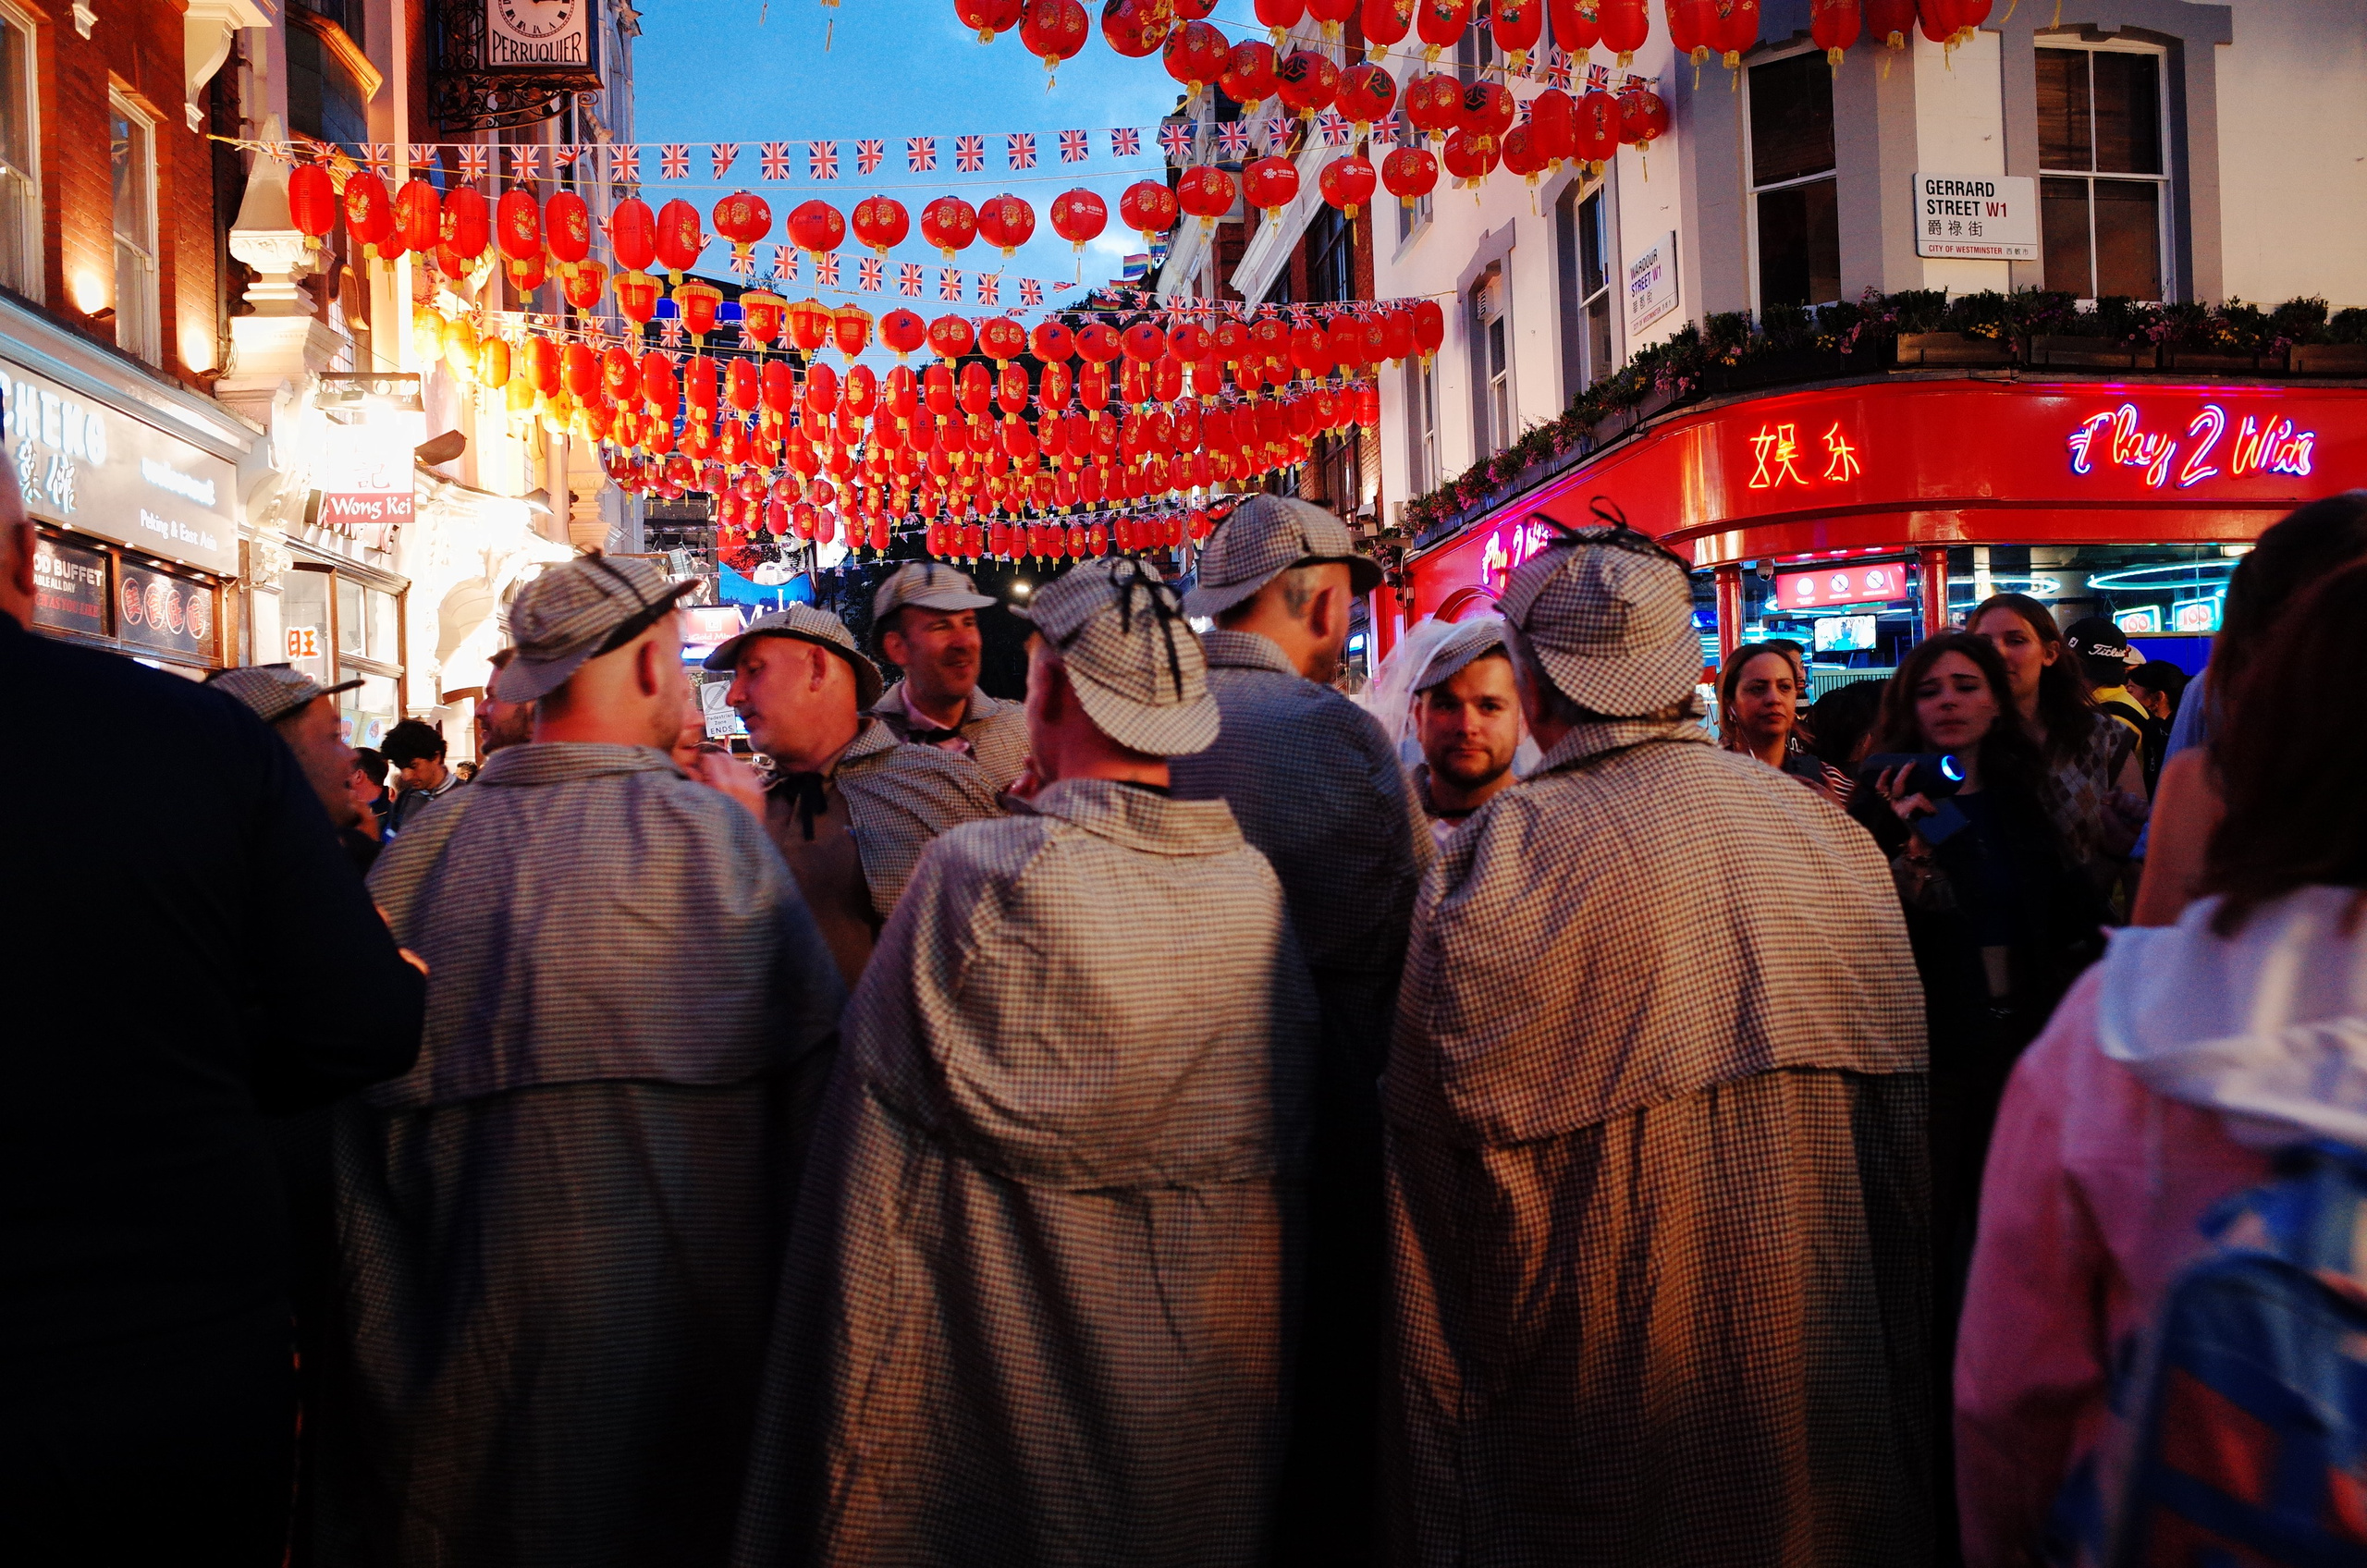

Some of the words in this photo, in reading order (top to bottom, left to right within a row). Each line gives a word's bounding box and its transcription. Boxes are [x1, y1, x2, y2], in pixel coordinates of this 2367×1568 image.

[492, 29, 582, 63] PERRUQUIER
[1926, 179, 1994, 197] GERRARD
[1927, 200, 1981, 216] STREET
[1986, 202, 2007, 217] W1
[1928, 219, 1982, 237] 爵祿街
[1929, 244, 1944, 252] CITY
[1956, 246, 2003, 255] WESTMINSTER
[1630, 248, 1658, 280] WARDOUR
[1631, 271, 1651, 298] STREET
[1652, 263, 1662, 281] W1
[2067, 403, 2177, 488] Play
[2177, 404, 2225, 488] 2
[330, 496, 383, 520] Wong
[386, 496, 411, 516] Kei
[141, 508, 168, 539] Peking
[170, 521, 178, 538] &
[54, 558, 103, 587] BUFFET
[51, 578, 62, 591] ALL
[63, 582, 75, 594] DAY
[2123, 616, 2148, 631] 100
[2183, 606, 2209, 626] 100
[288, 630, 318, 658] 旺
[710, 725, 733, 735] ENDS
